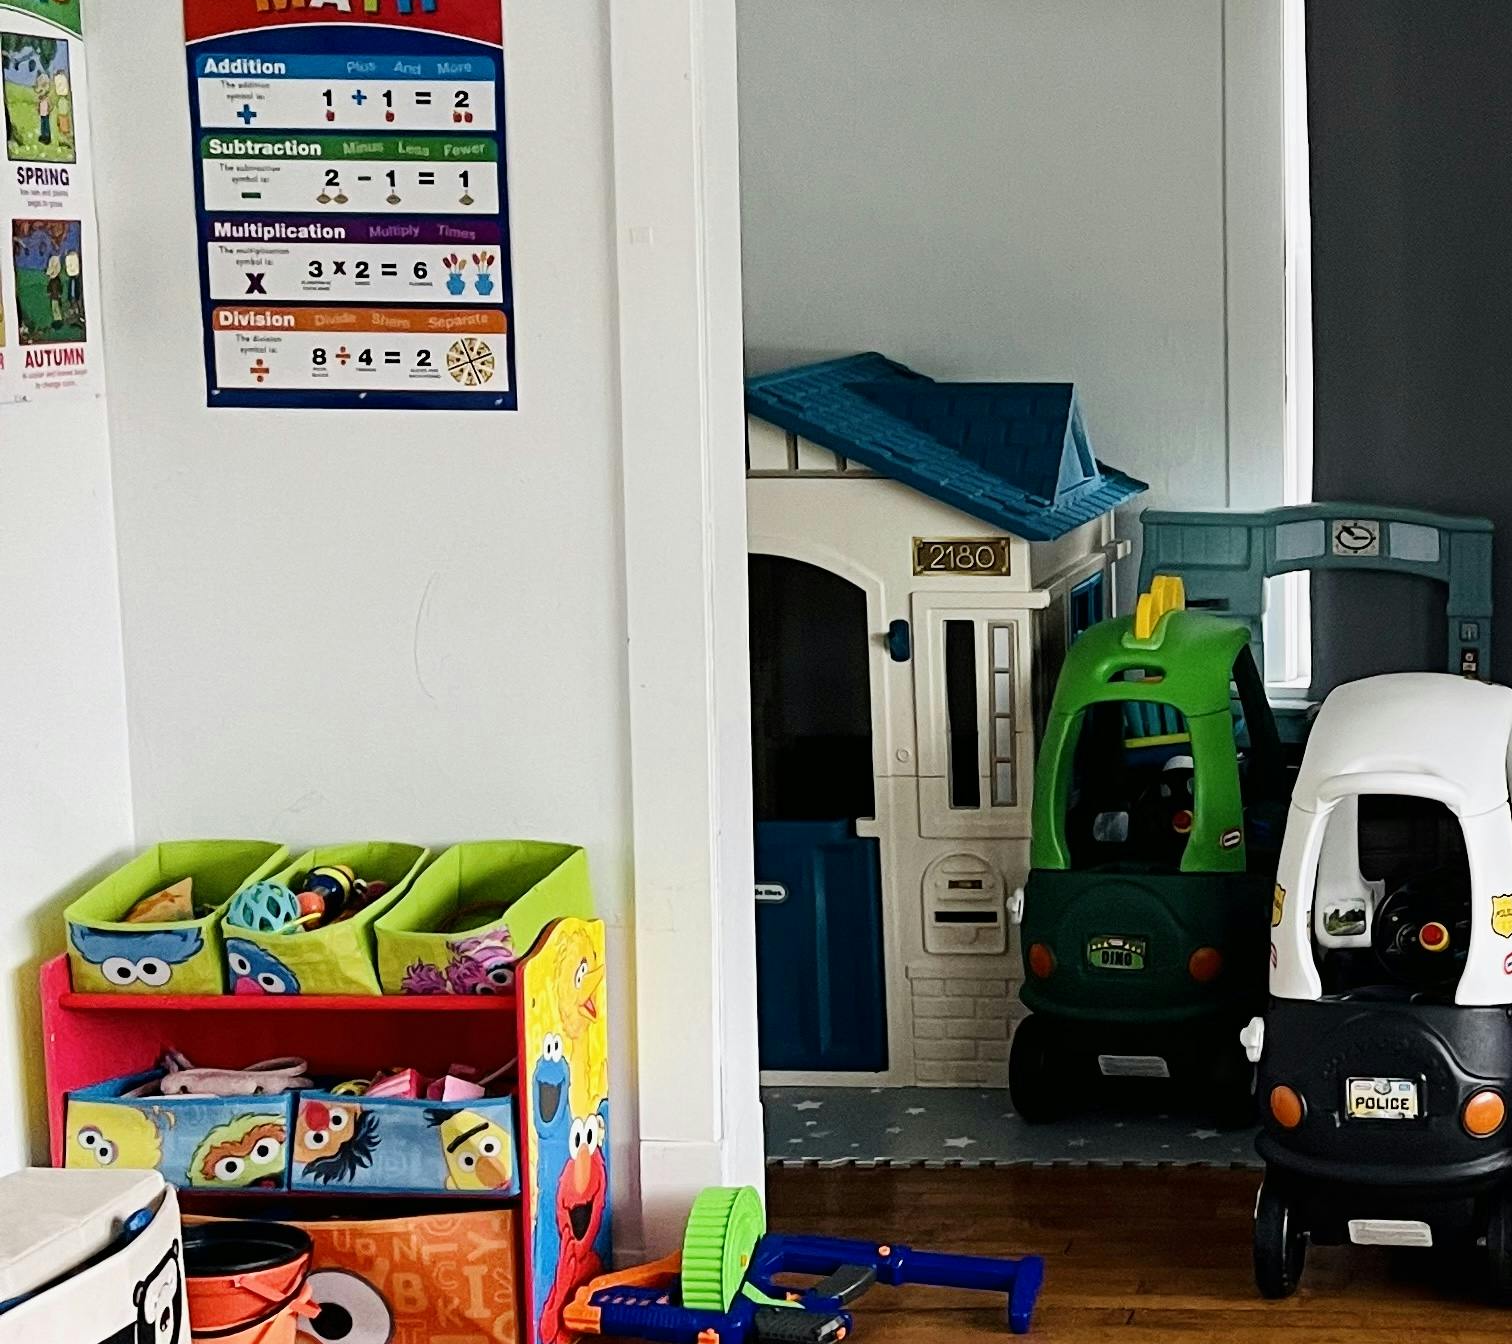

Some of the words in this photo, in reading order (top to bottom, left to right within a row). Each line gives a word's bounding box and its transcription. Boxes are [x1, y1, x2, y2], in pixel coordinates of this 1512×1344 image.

[204, 58, 286, 74] Addition
[346, 61, 376, 73] Plus
[393, 61, 421, 75] And
[437, 62, 472, 74] More
[322, 89, 332, 106] 1
[382, 90, 392, 107] 1
[454, 90, 469, 108] 2
[209, 139, 321, 156] Subtraction
[343, 142, 384, 154] Minus
[444, 143, 485, 156] Fewer
[17, 167, 69, 185] SPRING
[325, 169, 340, 186] 2
[386, 170, 395, 187] 1
[459, 170, 468, 187] 1
[214, 222, 346, 241] Multiplication
[369, 225, 420, 238] Multiply
[437, 224, 476, 240] Times
[308, 260, 323, 278] 3
[355, 261, 370, 278] 2
[413, 262, 427, 279] 6
[220, 311, 295, 327] Division
[315, 312, 357, 326] Divide
[428, 314, 488, 330] Separate
[25, 347, 84, 368] AUTUMN
[312, 348, 327, 365] 8
[358, 349, 373, 366] 4
[416, 349, 432, 367] 2
[930, 545, 994, 568] 2180
[1101, 951, 1132, 966] DINO
[1356, 1097, 1409, 1110] POLICE
